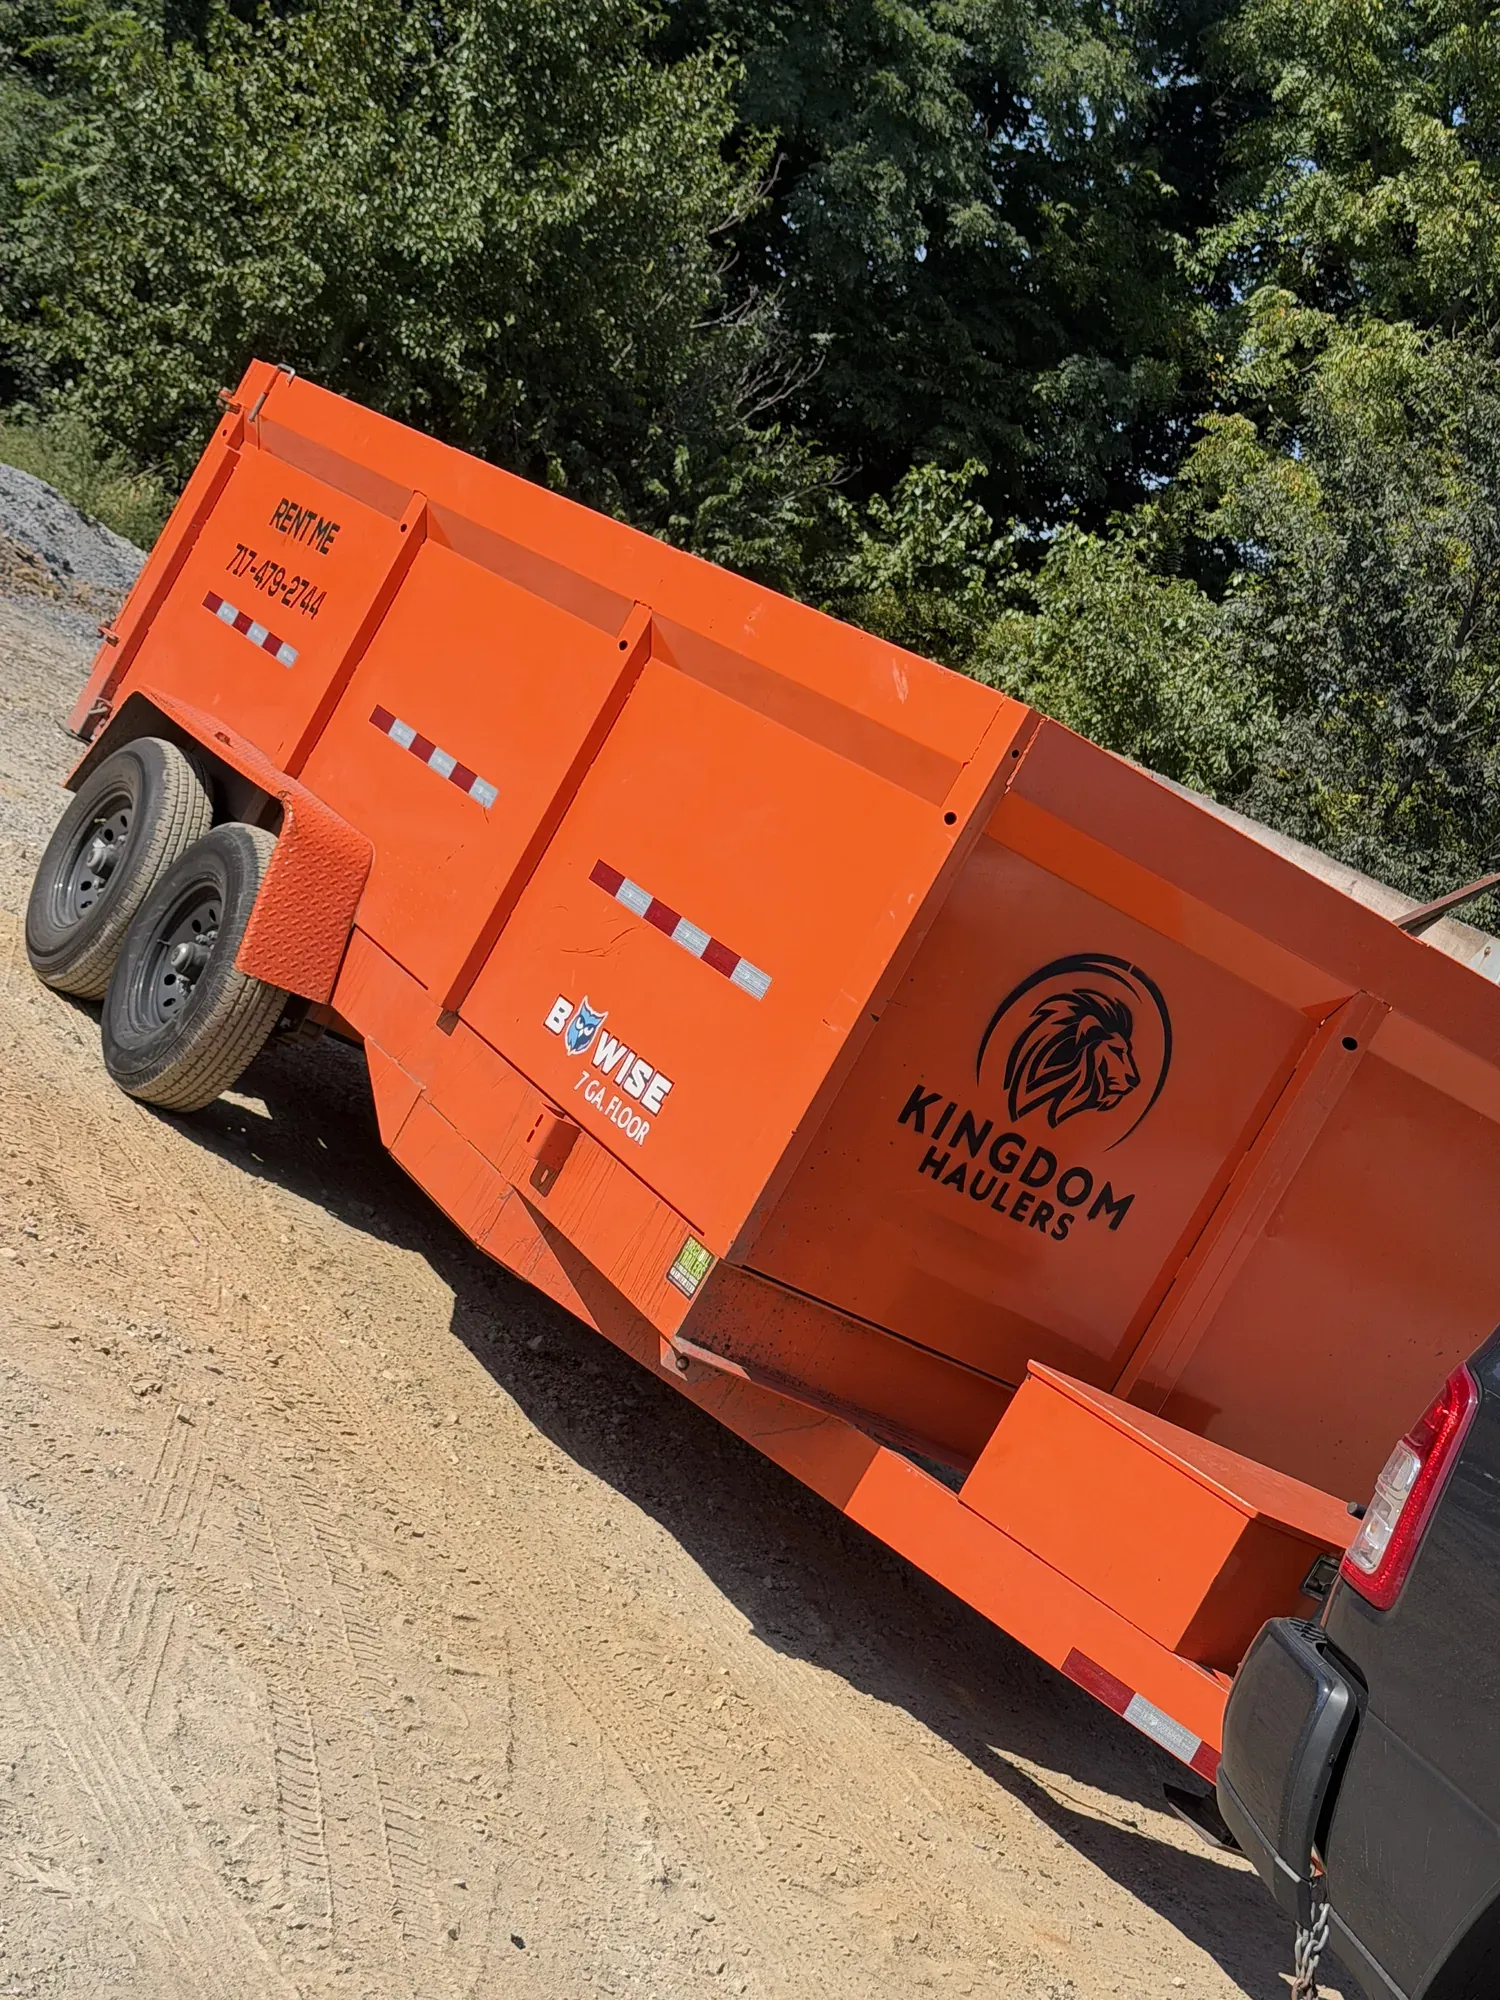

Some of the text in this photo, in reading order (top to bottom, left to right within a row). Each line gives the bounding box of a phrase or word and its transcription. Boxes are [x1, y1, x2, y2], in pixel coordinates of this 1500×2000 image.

[269, 498, 341, 555] RENT ME
[225, 543, 328, 621] 717-479-2744
[573, 1070, 590, 1091] 7
[604, 1096, 651, 1146] FLOOR
[897, 1084, 1135, 1231] KINGDOM
[917, 1145, 1075, 1241] HAULERS
